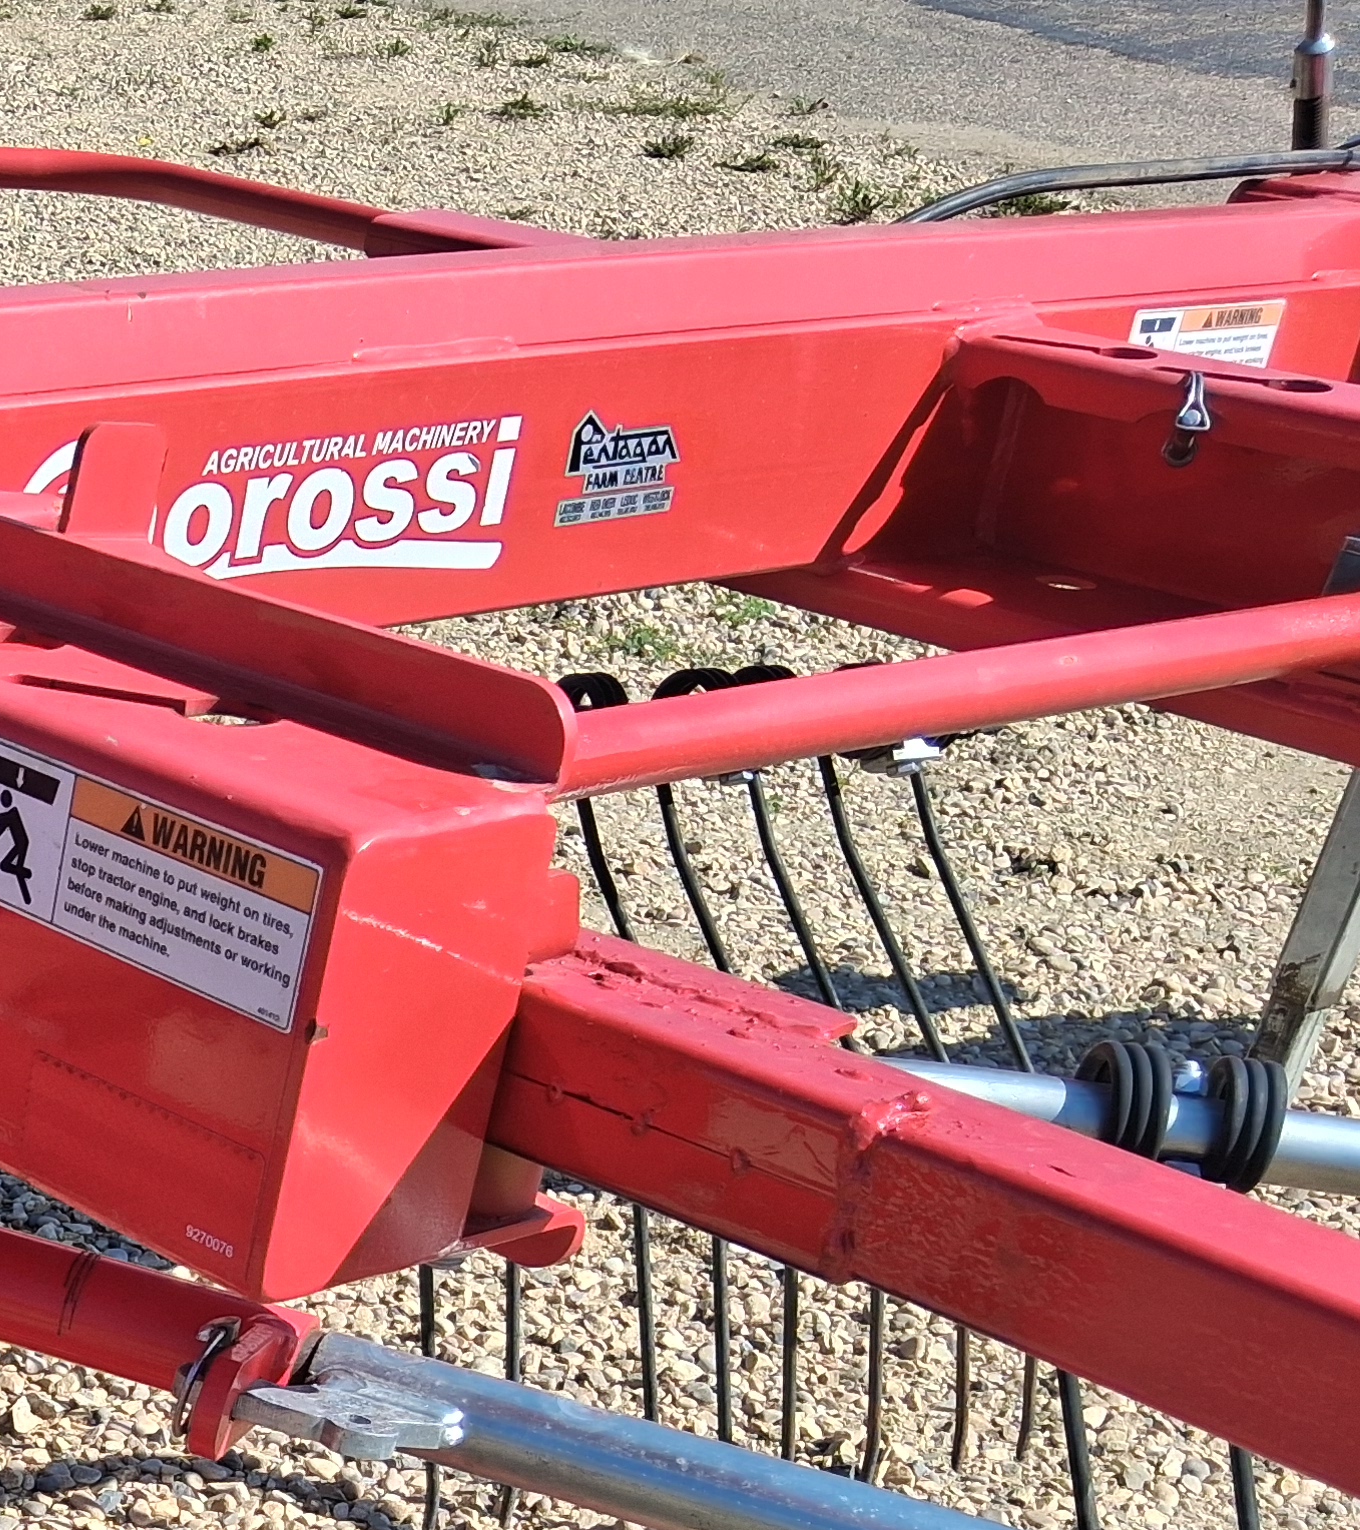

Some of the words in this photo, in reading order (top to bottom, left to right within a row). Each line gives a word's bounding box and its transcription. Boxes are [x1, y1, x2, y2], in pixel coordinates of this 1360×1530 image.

[1215, 307, 1263, 327] WARNING
[202, 433, 367, 477] AGRICULTURAL
[372, 419, 497, 457] MACHINERY
[568, 415, 677, 473] Pentagon
[152, 812, 267, 889] WARNING
[71, 856, 96, 877] stop
[98, 866, 136, 893] tractor
[138, 886, 180, 915] engine,
[183, 905, 206, 923] and
[208, 913, 234, 937] lock
[237, 926, 280, 955] brakes
[75, 832, 109, 857] Lower
[111, 850, 160, 879] machine
[163, 869, 174, 885] to
[178, 878, 197, 896] put
[200, 888, 241, 914] weight
[243, 906, 259, 921] on
[263, 911, 294, 939] tires,
[64, 901, 96, 923] under
[98, 914, 117, 933] the
[118, 924, 170, 957] machine.
[67, 876, 103, 902] before
[105, 895, 147, 925] making
[149, 914, 222, 955] adjustments
[225, 948, 239, 962] or
[241, 952, 291, 989] working
